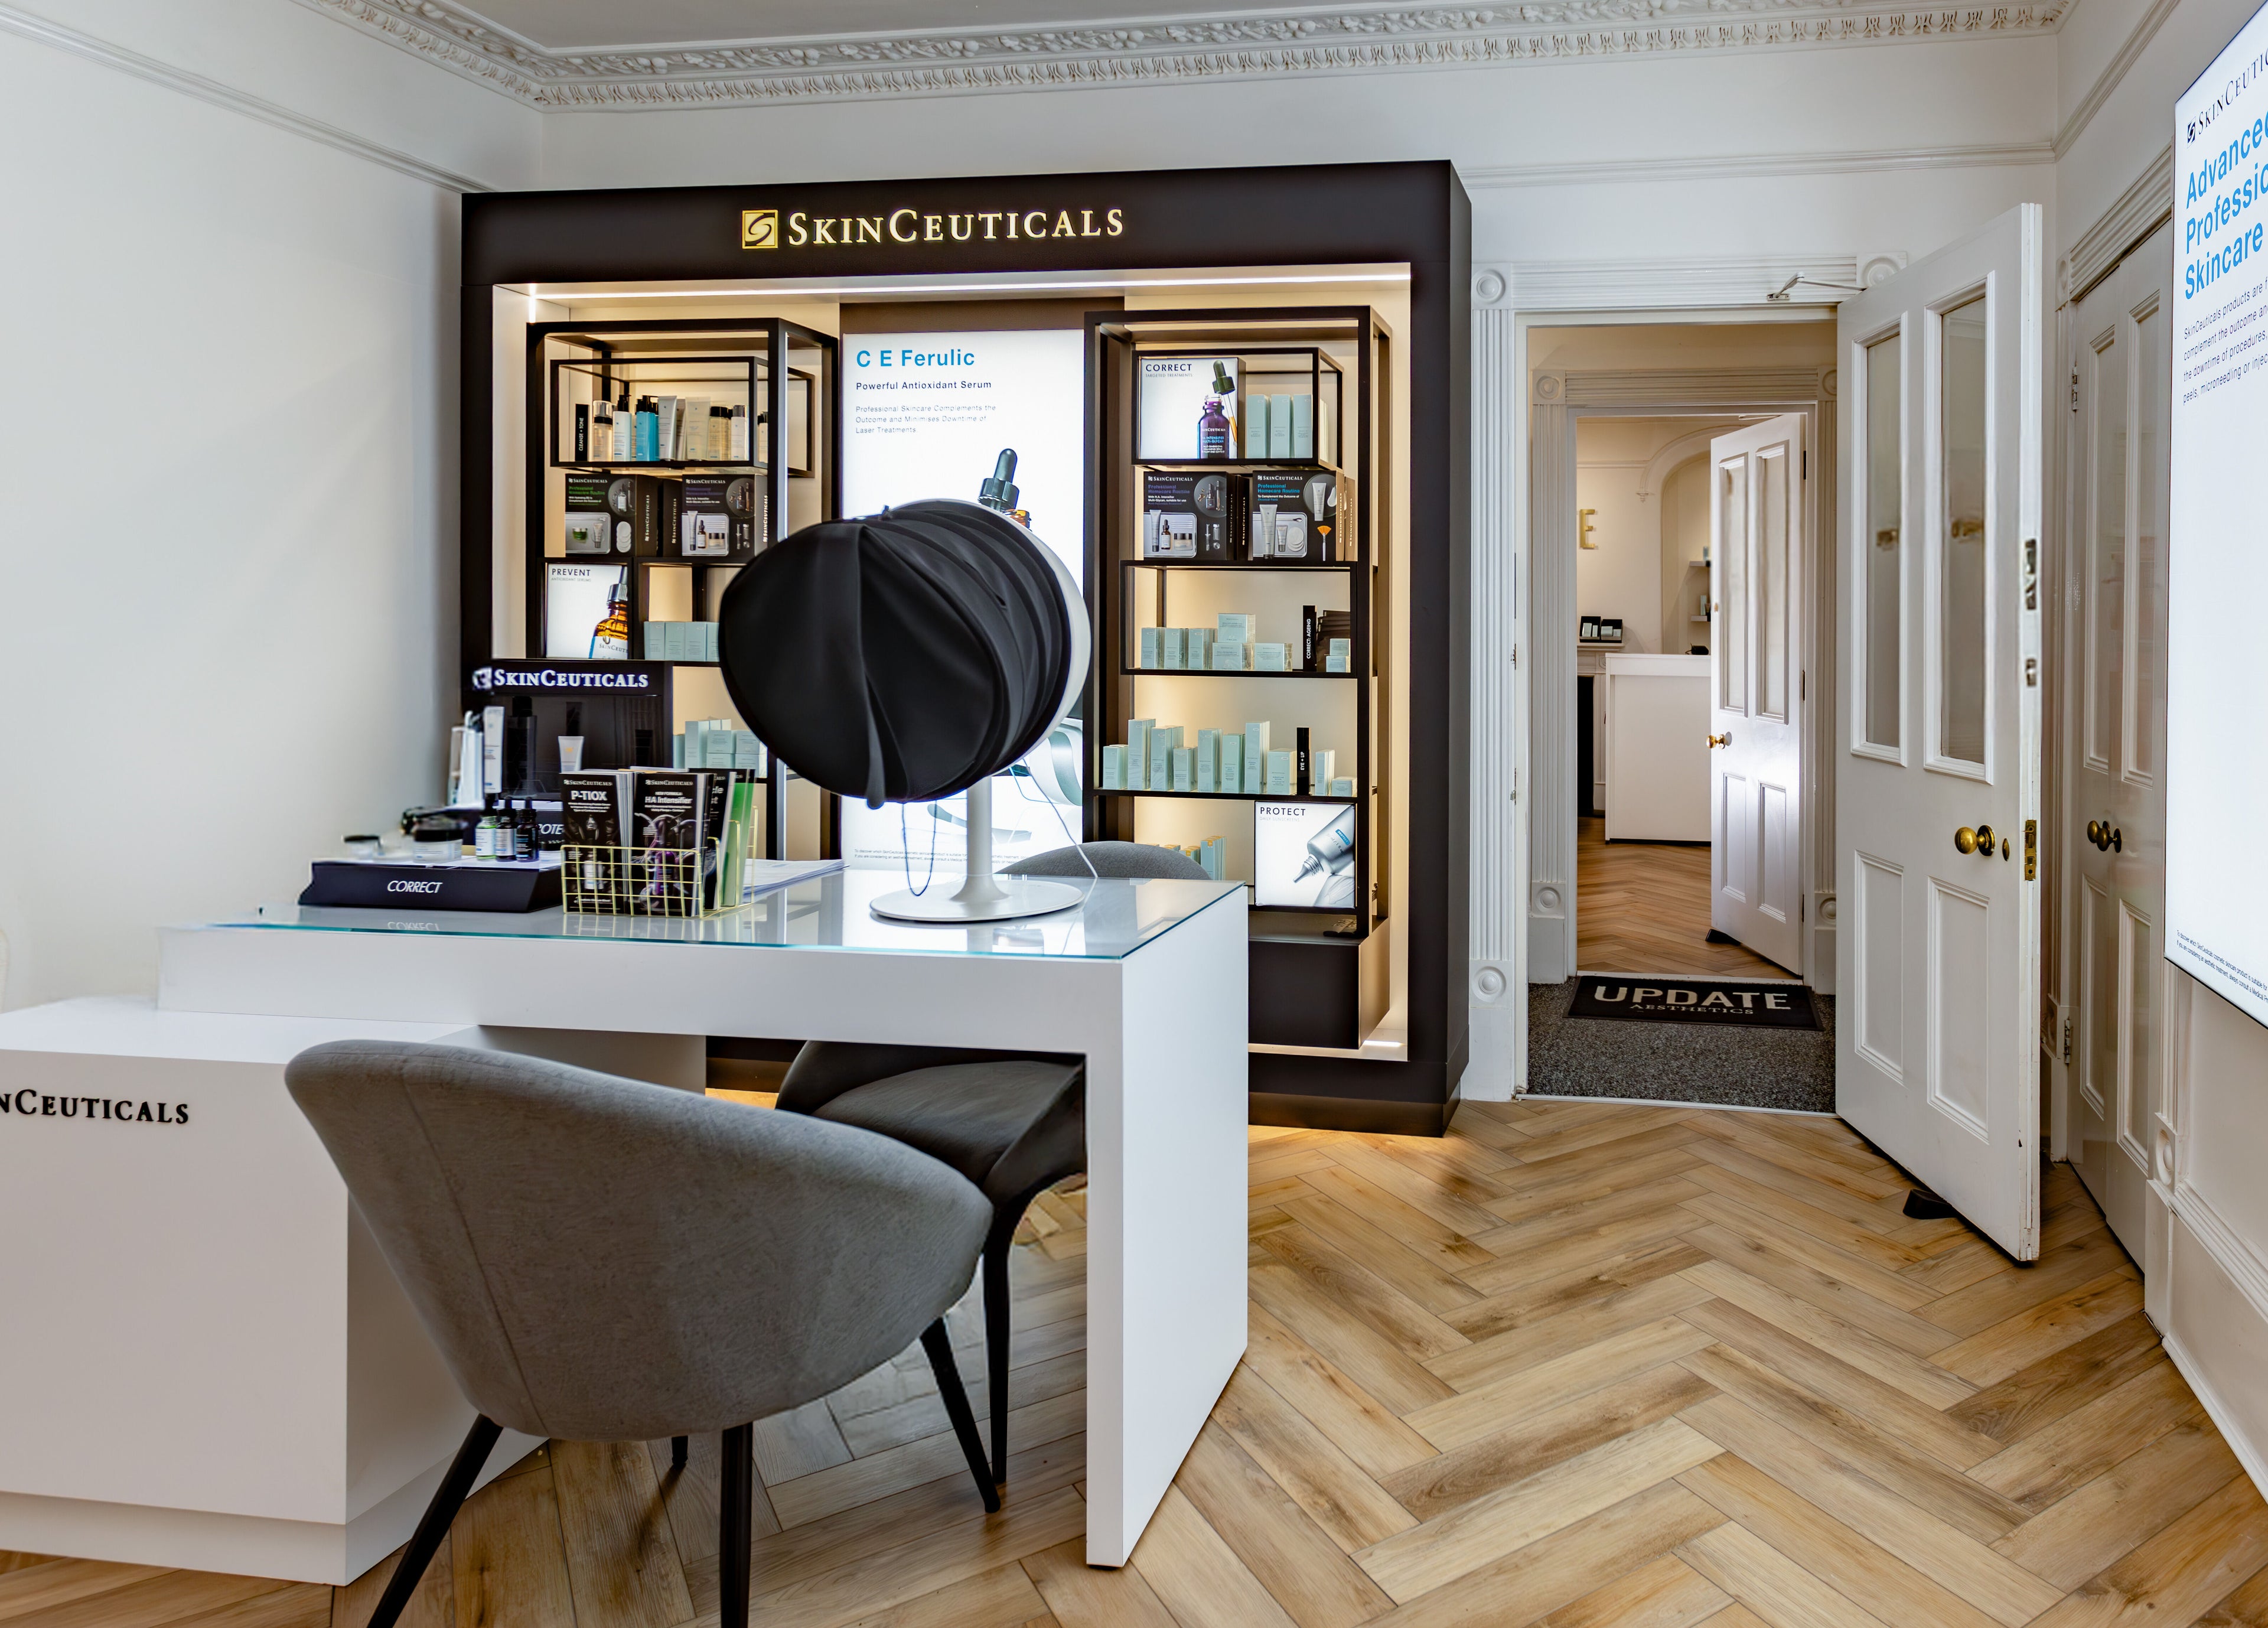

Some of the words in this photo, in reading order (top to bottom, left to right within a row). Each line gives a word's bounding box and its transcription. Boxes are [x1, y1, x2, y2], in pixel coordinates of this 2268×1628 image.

[788, 208, 1124, 246] SKINCEUTICALS
[2185, 222, 2263, 299] Skincare
[2184, 309, 2221, 340] SkinCeuticals
[2223, 291, 2250, 318] products
[2253, 282, 2263, 298] are
[2184, 333, 2217, 360] complement
[2218, 328, 2228, 341] the
[2230, 311, 2257, 334] outcome
[2259, 305, 2268, 318] an
[857, 350, 871, 367] C
[880, 350, 892, 366] E
[901, 349, 975, 366] Ferulic
[2184, 370, 2192, 382] the
[2194, 354, 2220, 376] downtime
[2222, 347, 2228, 361] of
[2230, 330, 2267, 360] procedures,
[2183, 388, 2199, 406] peels,
[2201, 366, 2241, 395] microneedling
[2244, 362, 2250, 374] or
[552, 568, 591, 577] PREVENT
[494, 669, 649, 688] SKINCEUTICALS
[571, 790, 608, 801] P-TIOX
[1260, 807, 1306, 816] PROTECT
[387, 880, 443, 893] CORRECT
[1594, 985, 1791, 1010] UPDATE
[1630, 1004, 1754, 1015] AESTHETICS
